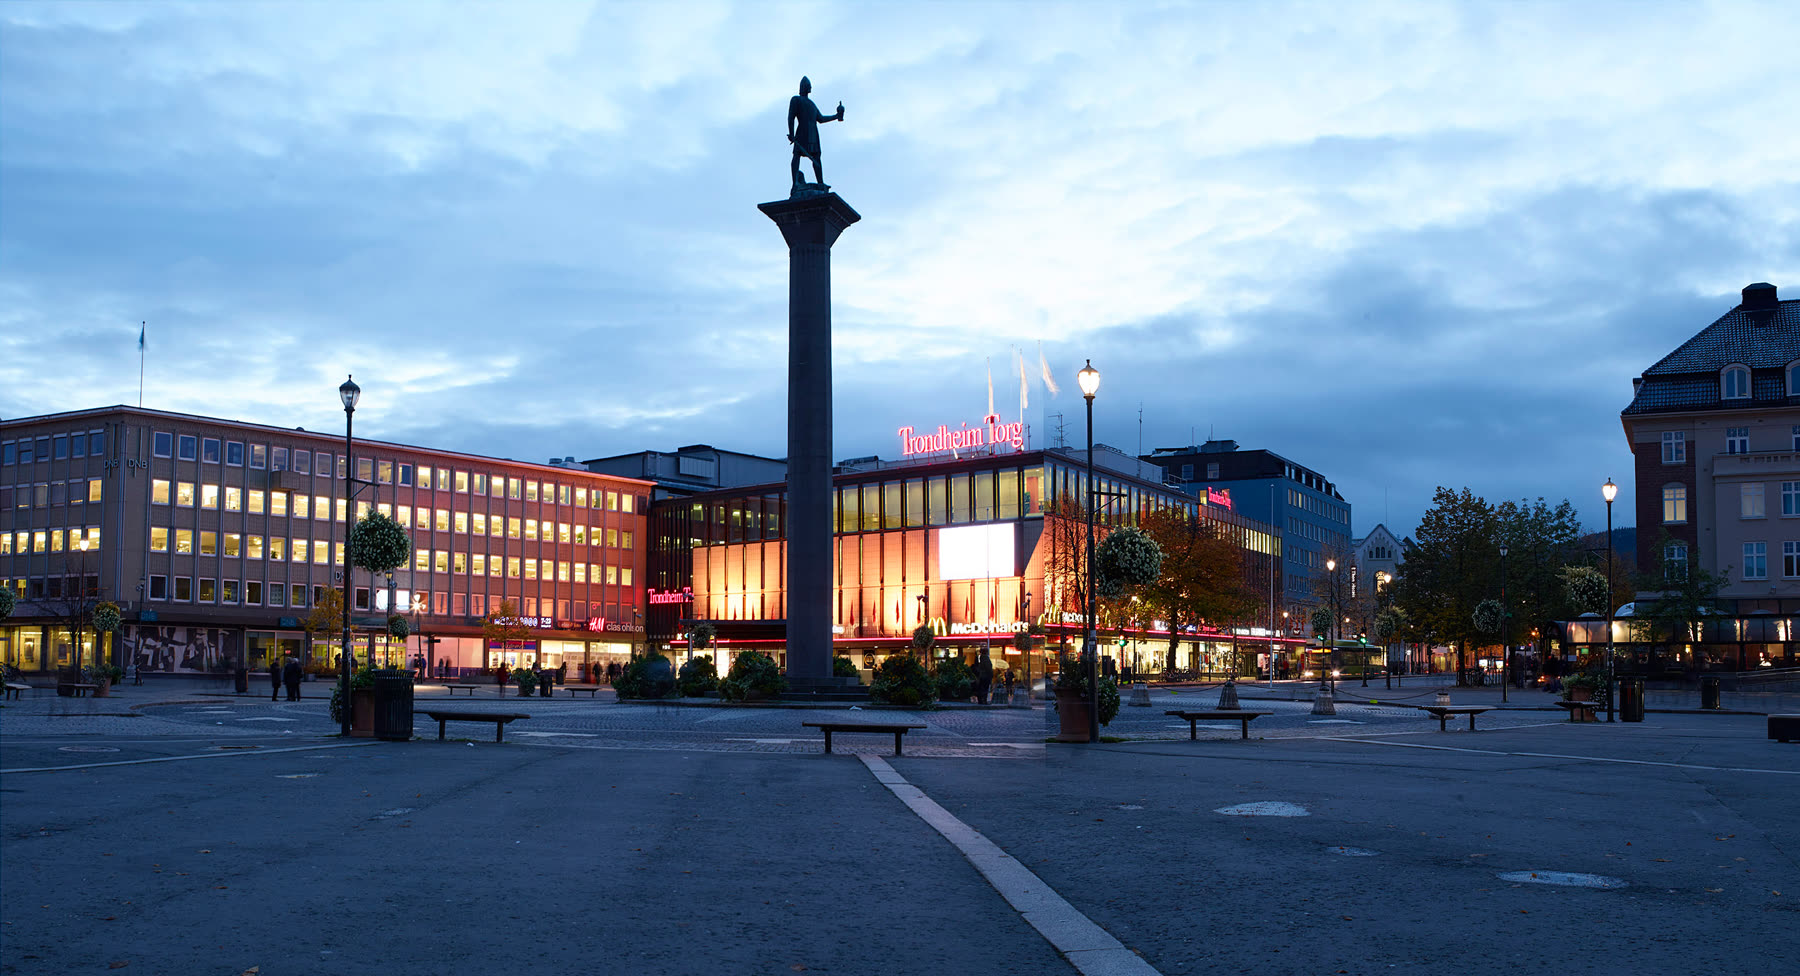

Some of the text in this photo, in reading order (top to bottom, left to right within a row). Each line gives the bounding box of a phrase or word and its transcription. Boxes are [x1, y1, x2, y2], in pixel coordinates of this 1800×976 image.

[898, 414, 1024, 455] Trondheim Torg
[128, 459, 148, 469] DNB
[647, 588, 683, 604] Trondheim
[606, 623, 644, 632] clas ohlson
[951, 622, 1029, 634] McDonald's
